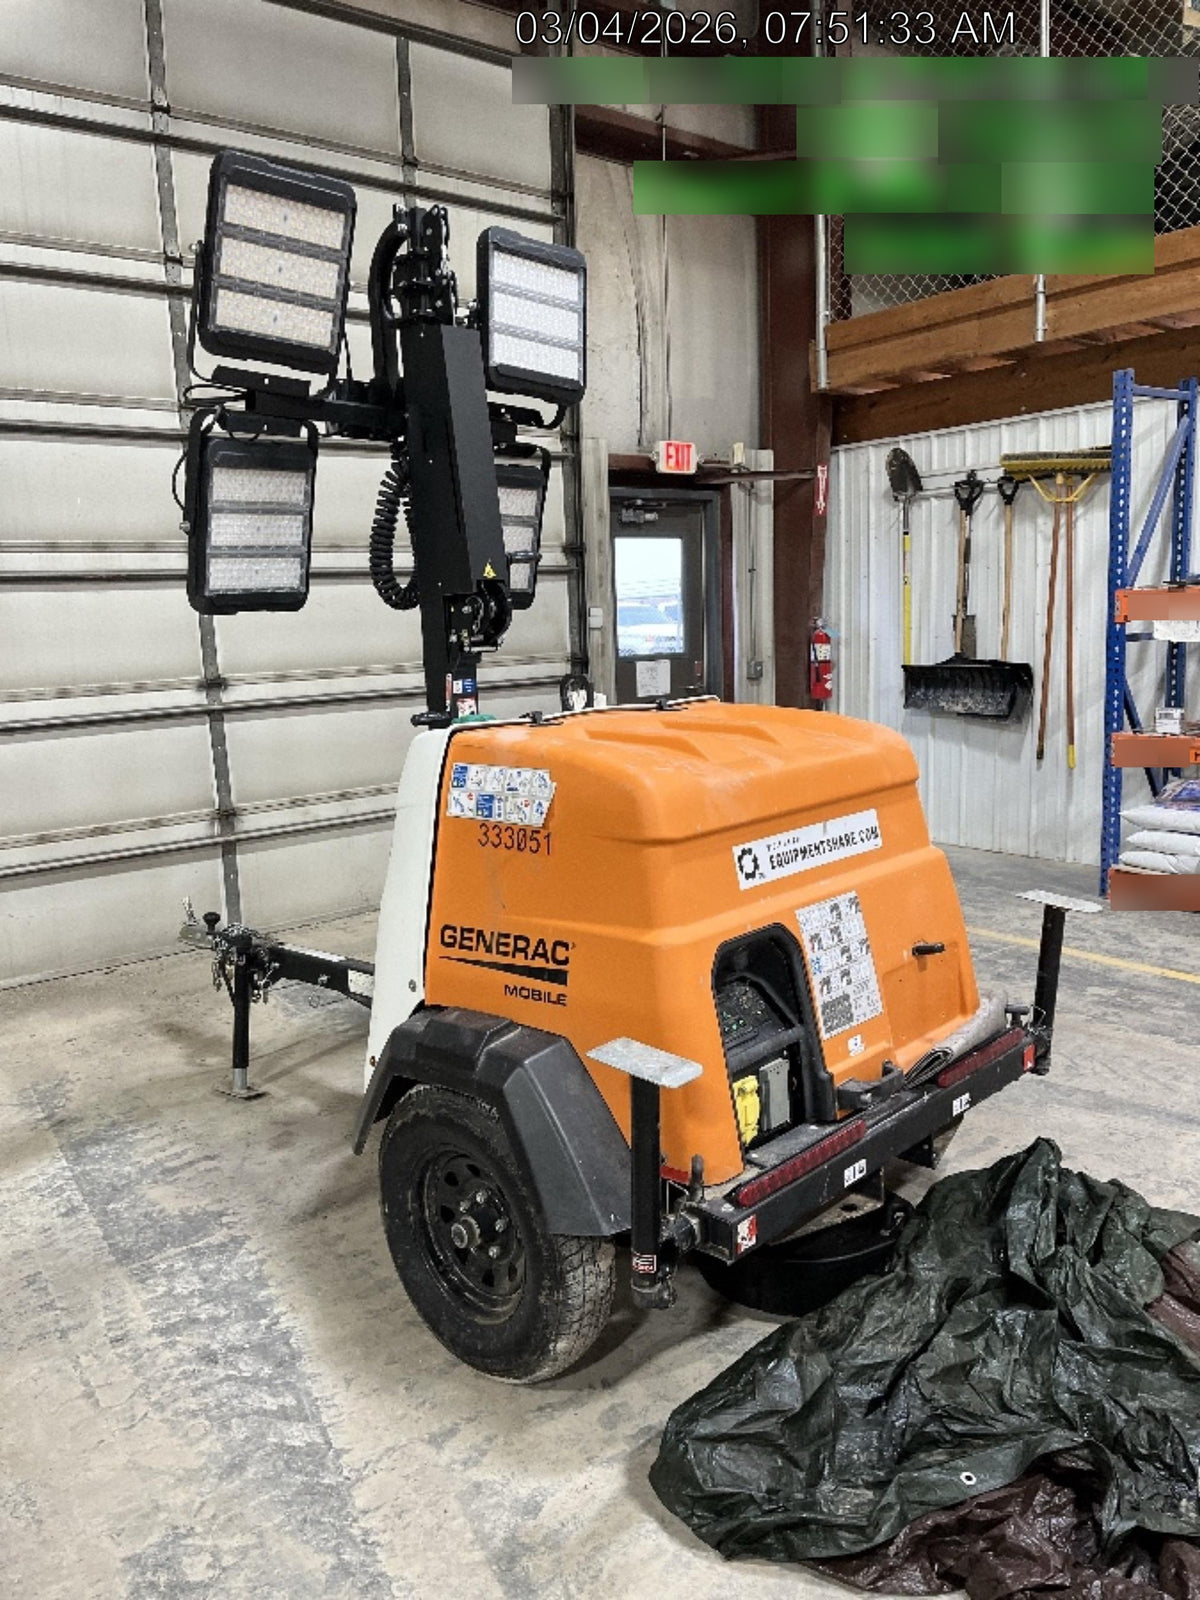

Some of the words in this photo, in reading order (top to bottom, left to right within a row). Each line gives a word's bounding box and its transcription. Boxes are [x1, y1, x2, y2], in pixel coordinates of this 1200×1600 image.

[666, 442, 692, 471] EXIT
[478, 823, 552, 855] 333051
[440, 924, 570, 966] GENERAC
[504, 984, 568, 1007] MOBILE
